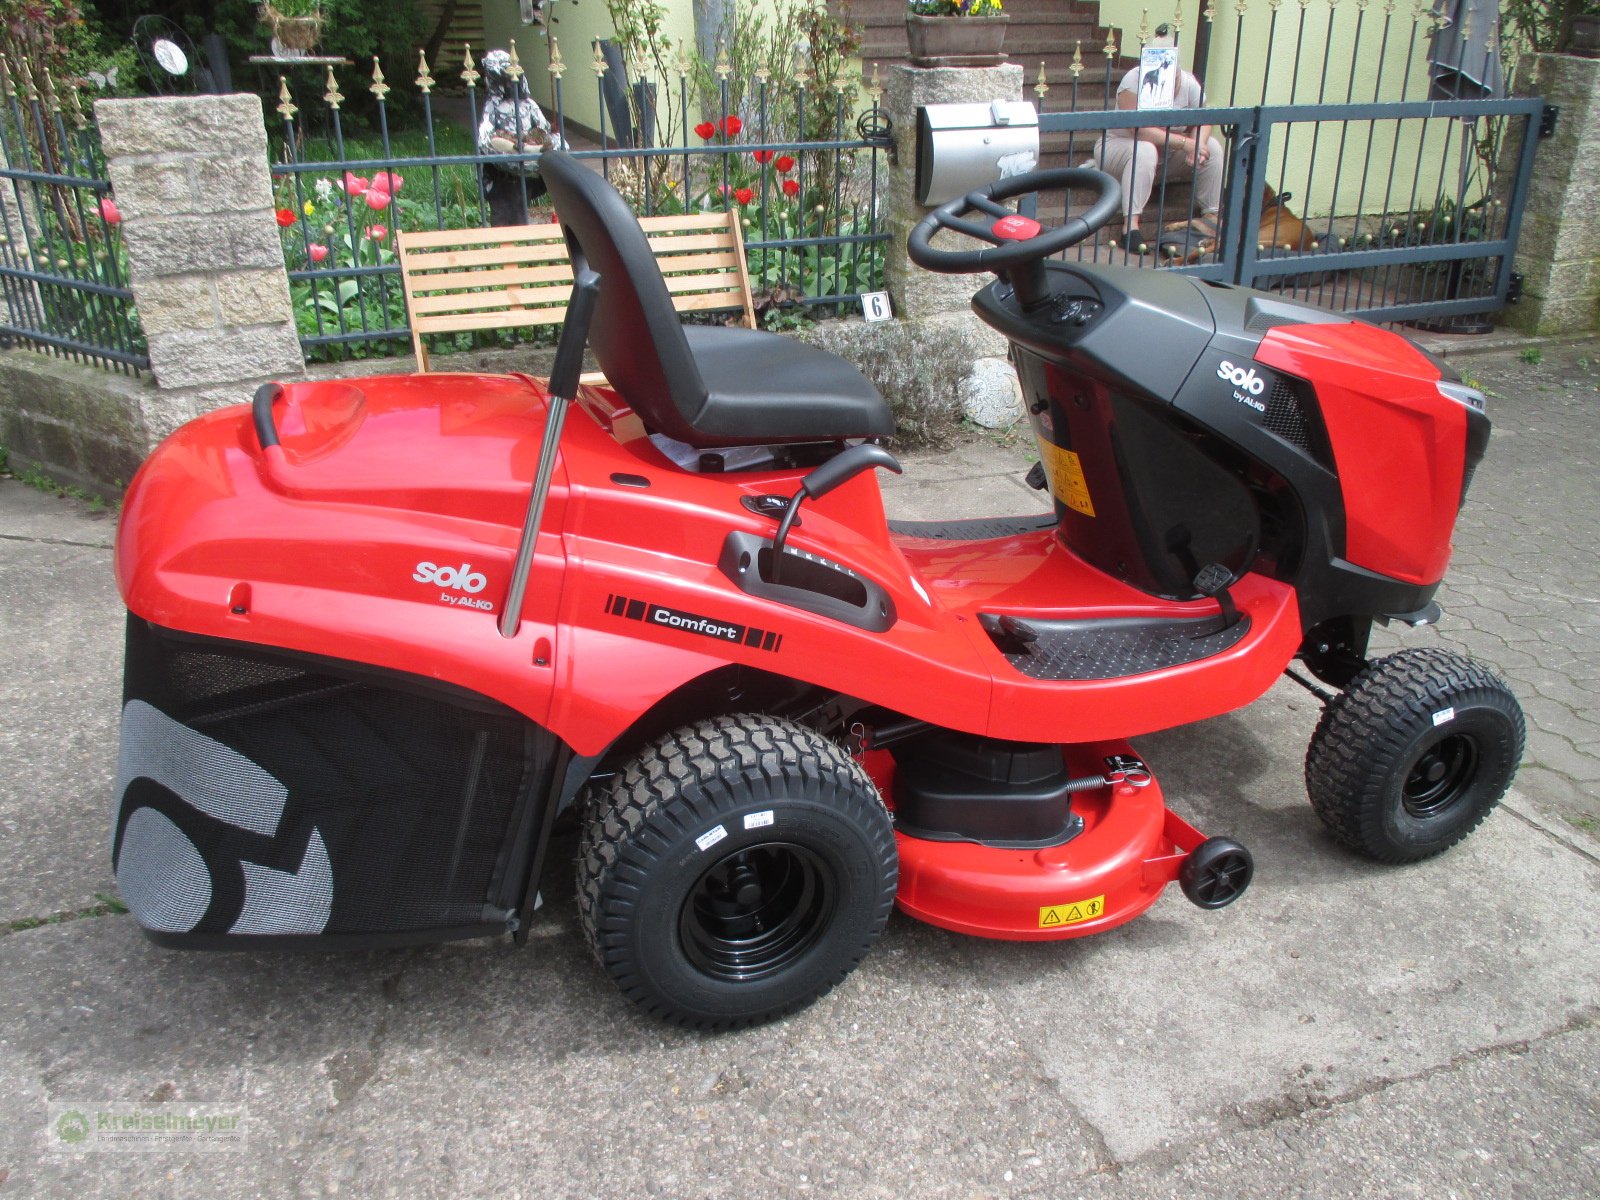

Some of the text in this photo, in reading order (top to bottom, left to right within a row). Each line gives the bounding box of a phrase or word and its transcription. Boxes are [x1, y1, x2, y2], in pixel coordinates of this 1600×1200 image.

[872, 296, 882, 317] 6
[1216, 360, 1265, 395] solo
[1233, 390, 1245, 402] by
[412, 561, 487, 593] solo
[440, 592, 458, 605] by
[654, 609, 737, 639] Comfort
